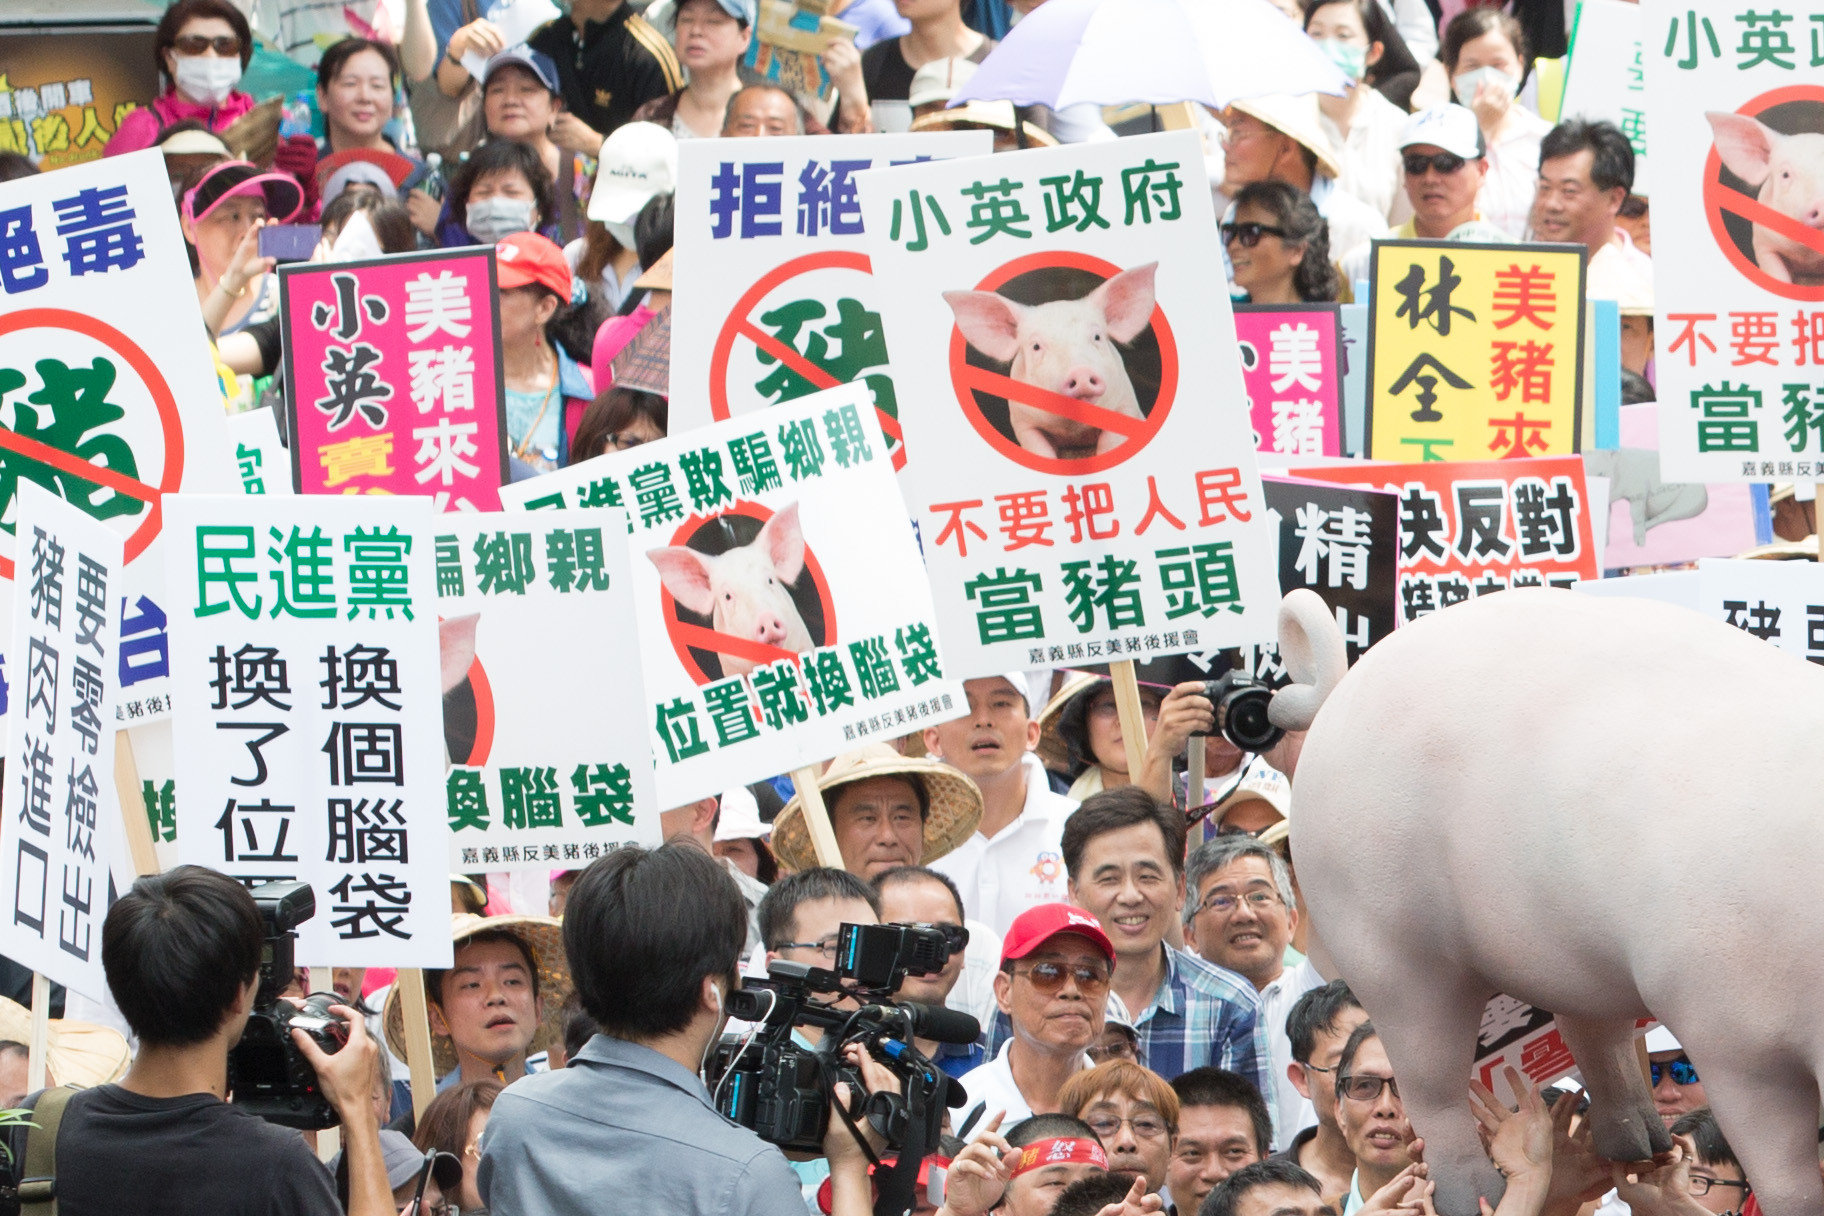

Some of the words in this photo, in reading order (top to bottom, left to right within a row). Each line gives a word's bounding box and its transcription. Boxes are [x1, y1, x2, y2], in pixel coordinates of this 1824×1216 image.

[710, 157, 956, 239] 拒絕
[890, 157, 1184, 252] 小英政府
[929, 467, 1252, 557] 不要把人民
[194, 523, 415, 622] 民進黨
[964, 541, 1246, 646] 當豬頭
[653, 621, 943, 769] 位置就換腦袋
[1028, 629, 1200, 665] 嘉義縣反美豬後援會
[13, 524, 65, 941] 豬肉進口
[58, 551, 109, 963] 要零檢出
[843, 693, 955, 741] 嘉義縣反美豬後援會
[209, 643, 299, 938] 換了位
[319, 642, 412, 941] 換個腦袋
